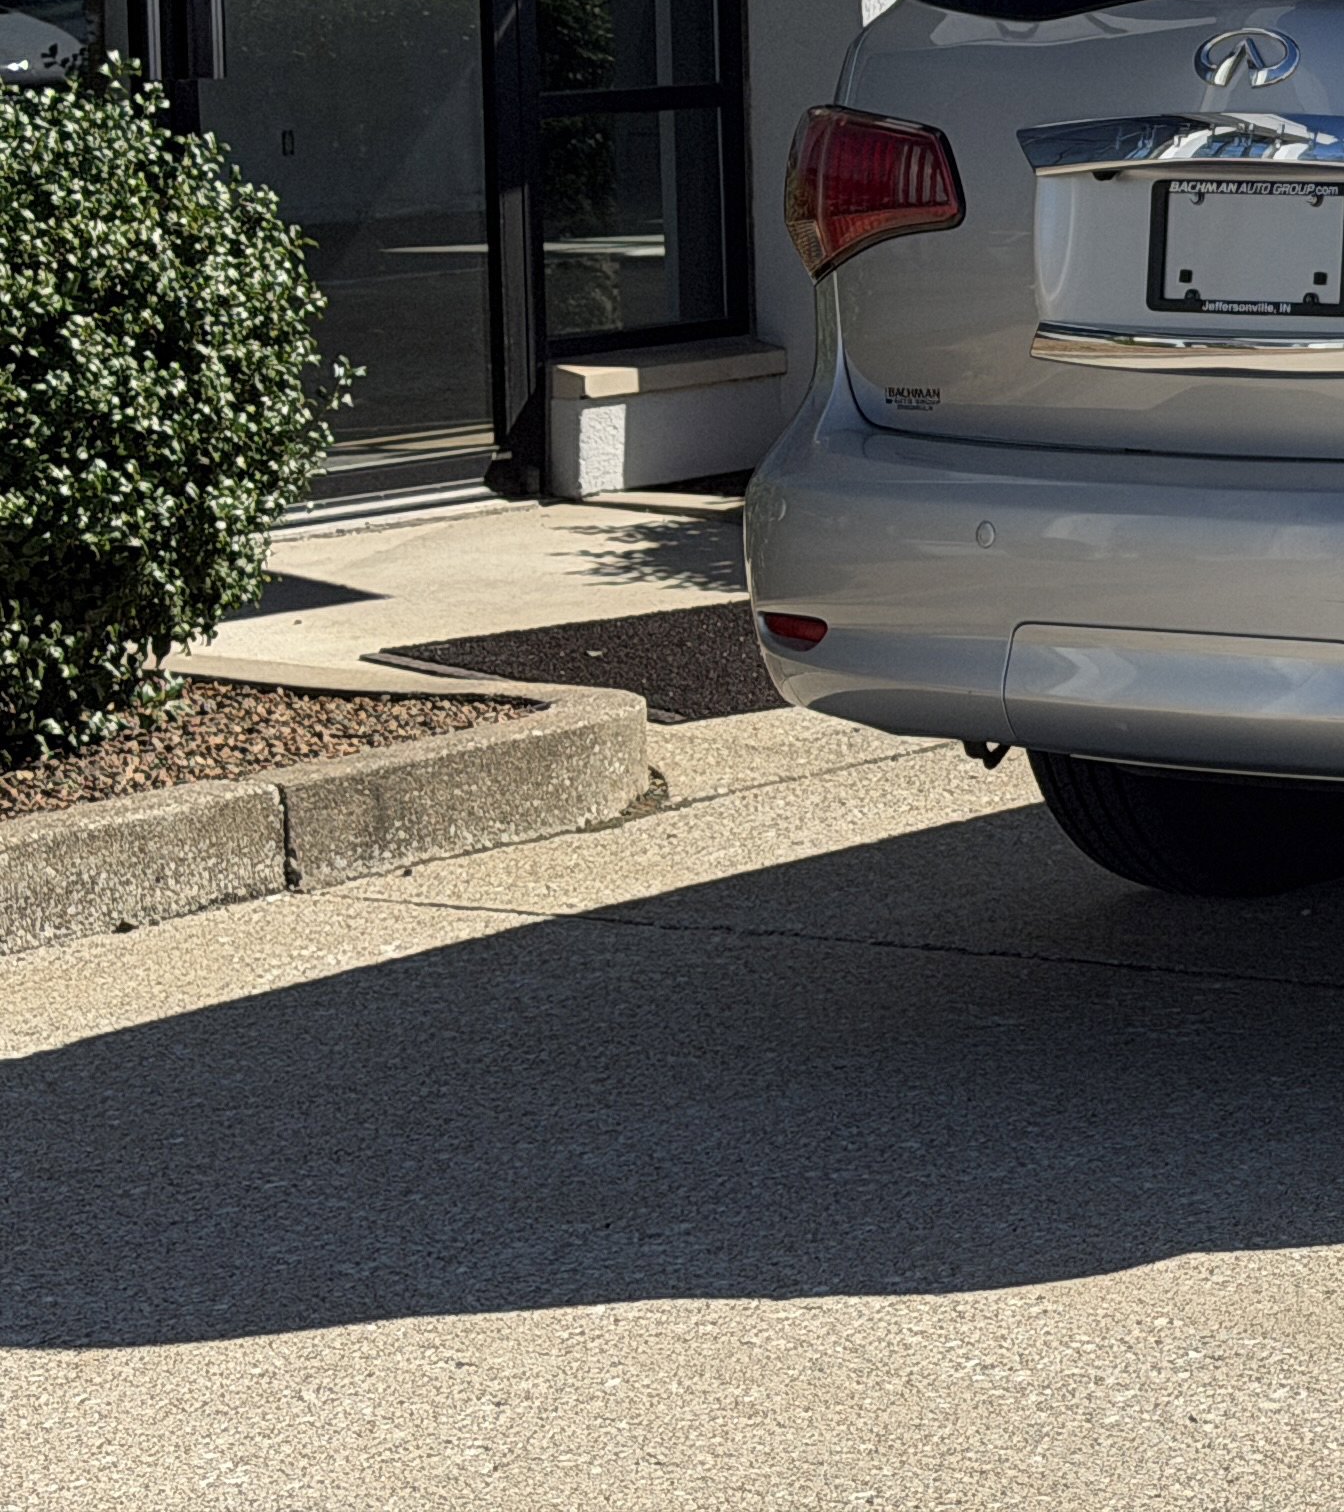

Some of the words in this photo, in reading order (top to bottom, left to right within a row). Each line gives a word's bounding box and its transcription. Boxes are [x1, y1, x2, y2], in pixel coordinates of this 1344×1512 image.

[1168, 181, 1238, 194] BACHMAN
[1238, 183, 1271, 195] AUTO
[1201, 300, 1277, 314] Jeffersonville,
[1279, 303, 1292, 314] IN
